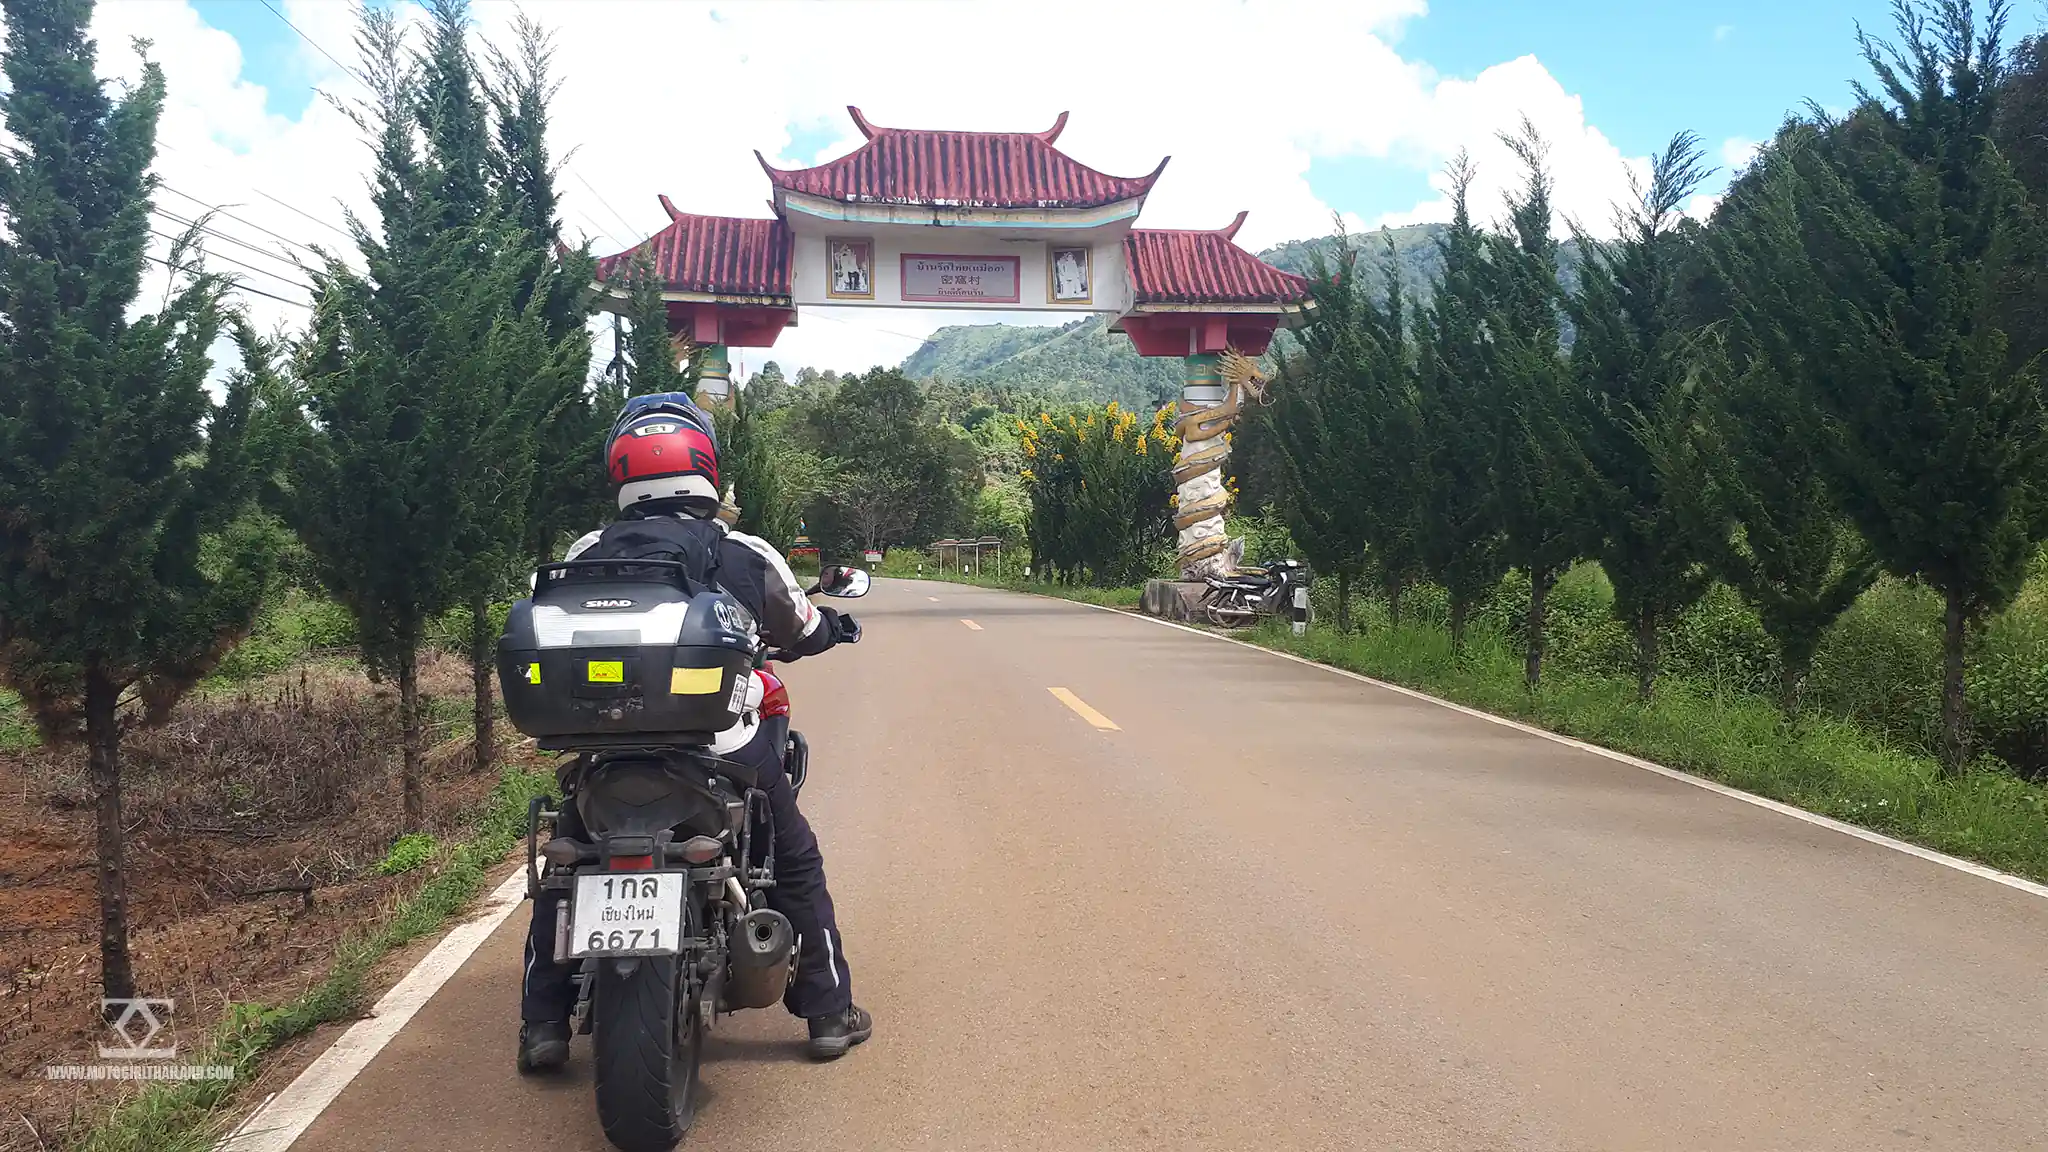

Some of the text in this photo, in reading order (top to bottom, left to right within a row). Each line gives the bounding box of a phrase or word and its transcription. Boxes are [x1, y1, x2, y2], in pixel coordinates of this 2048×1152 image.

[586, 600, 631, 608] SHAD
[601, 904, 654, 921] เชียงใหม่
[588, 928, 660, 950] 6671
